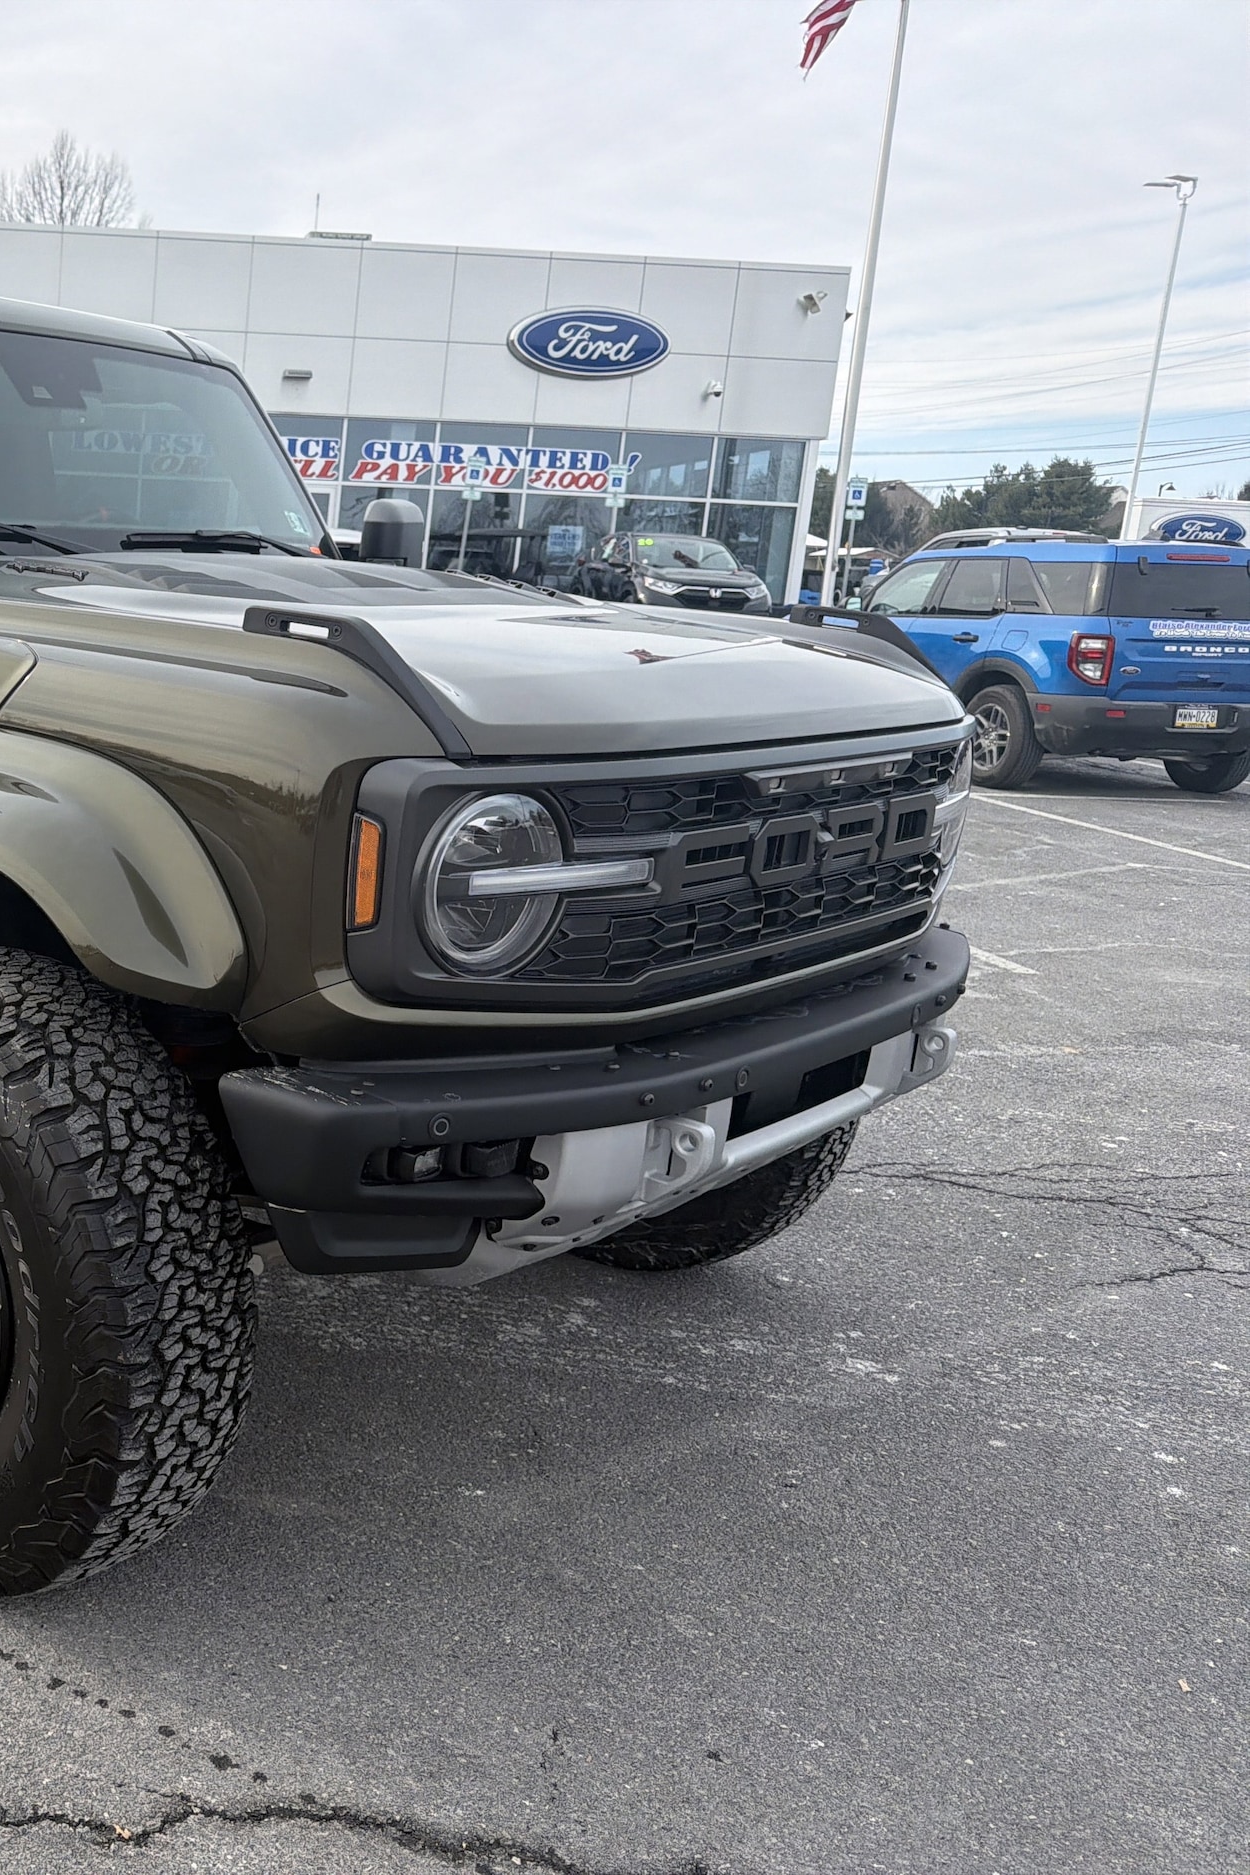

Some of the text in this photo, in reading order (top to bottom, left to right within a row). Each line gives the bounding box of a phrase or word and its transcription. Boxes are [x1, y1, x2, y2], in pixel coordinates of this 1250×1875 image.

[547, 321, 639, 362] Ford
[287, 438, 339, 459] ICE
[351, 461, 431, 482] PAY
[529, 469, 608, 491] $1,000
[1175, 520, 1229, 540] Ford
[1164, 645, 1250, 653] BRONCO
[660, 790, 938, 905] FORD
